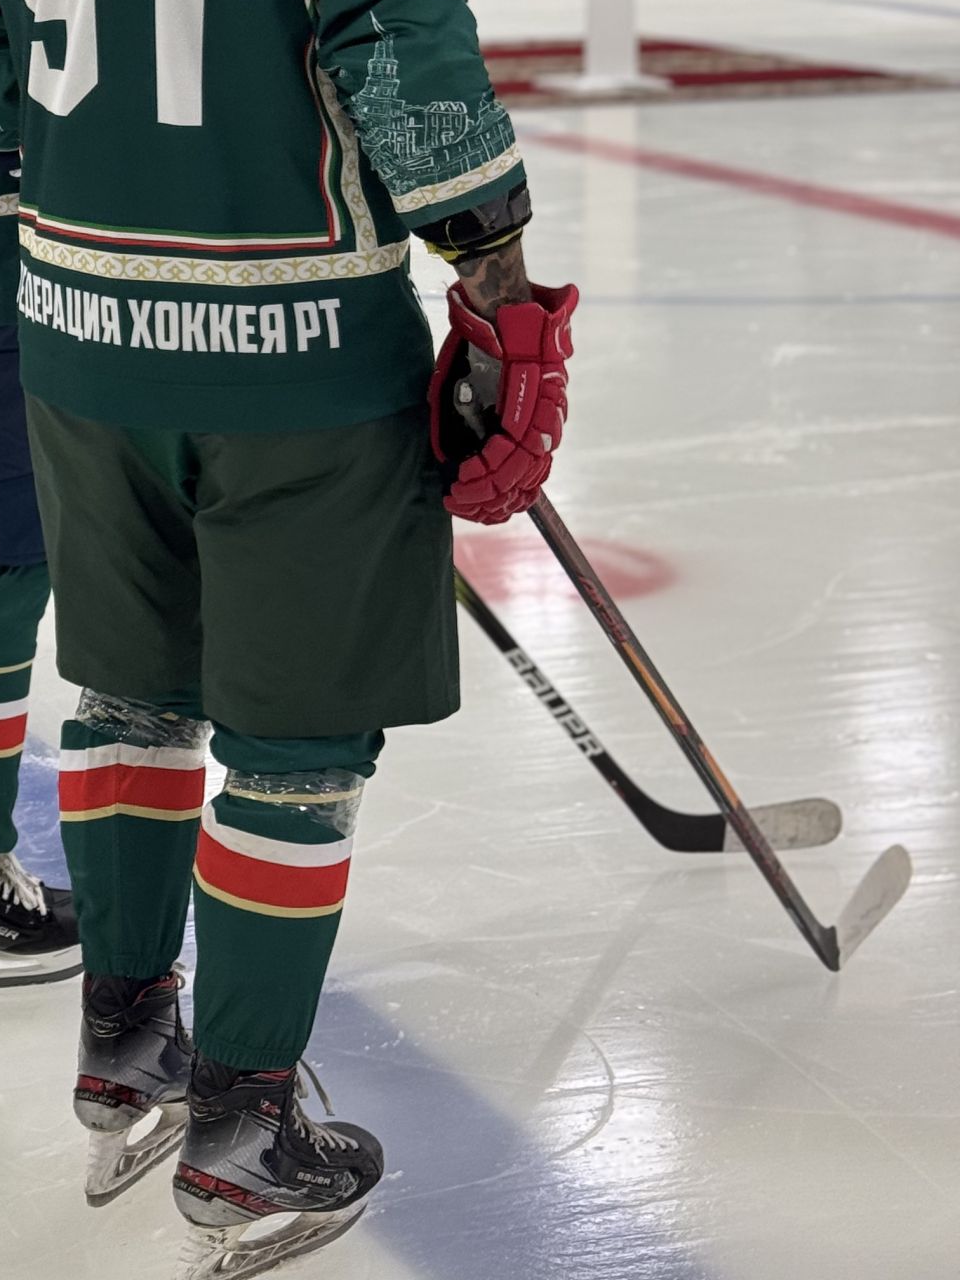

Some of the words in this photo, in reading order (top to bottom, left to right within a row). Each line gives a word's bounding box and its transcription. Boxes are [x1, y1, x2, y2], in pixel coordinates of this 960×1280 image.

[17, 260, 122, 346] ЕДЕРАЦИЯ
[127, 298, 287, 354] ХОККЕЯ
[293, 297, 340, 352] РТ
[503, 646, 607, 757] BAUER
[296, 1171, 332, 1187] BAUER
